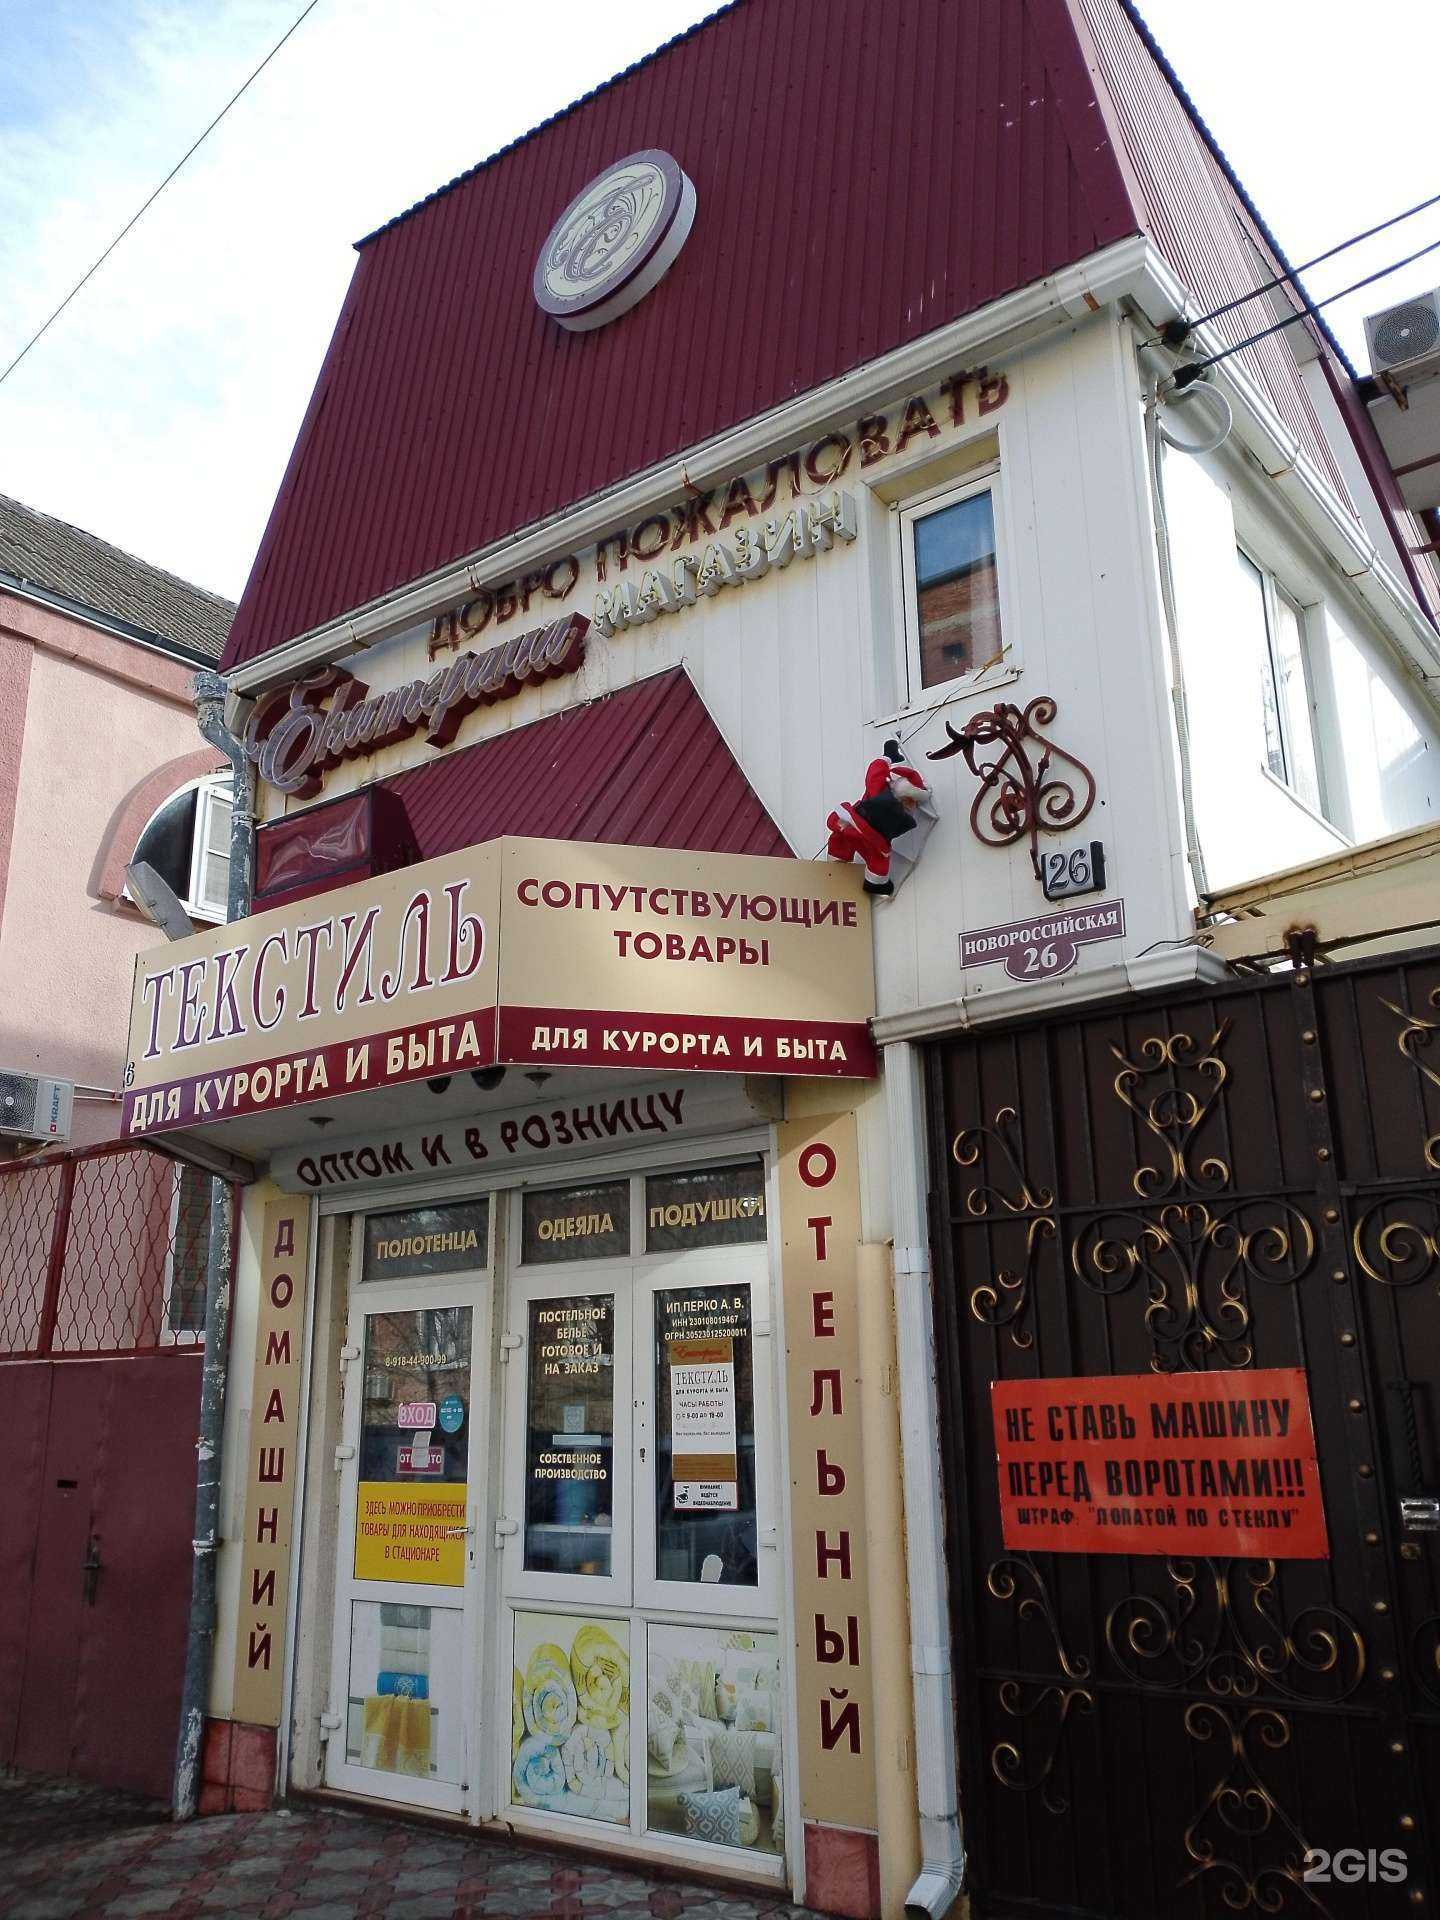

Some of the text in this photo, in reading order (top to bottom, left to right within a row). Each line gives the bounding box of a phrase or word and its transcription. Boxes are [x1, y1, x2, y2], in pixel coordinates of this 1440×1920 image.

[428, 364, 1010, 662] ДОБРО ПОЖАЛОВАТЬ
[592, 488, 858, 638] МАГАЗИН
[1047, 849, 1091, 891] 26
[515, 877, 859, 928] СОПУТСТВУЮЩИЕ
[613, 930, 771, 967] ТОВАРЫ
[964, 910, 1118, 955] НОВОРОССИЙСКАЯ
[142, 880, 484, 1060] ТЕКСТИЛЬ
[1023, 942, 1059, 973] 26
[531, 1026, 848, 1061] ДЛЯ КУРОРТА И БЫТА
[130, 1019, 482, 1134] ДЛЯ КУРОРТА И БЫТА
[50, 1084, 62, 1120] KRAFT
[295, 1089, 686, 1188] ОПТОМ И В РОЗНИЦУ
[537, 1212, 614, 1242] ОДЕЯЛА
[649, 1196, 765, 1229] ПОДУШКИ
[376, 1229, 478, 1260] ПОЛОТЕНЦА
[539, 1308, 606, 1323] ПОСТЕЛЬНОЕ
[666, 1298, 744, 1313] ИП ПЕРКО А. В.
[664, 1331, 684, 1341] ОГРН
[672, 1318, 688, 1327] ИНН
[542, 1343, 602, 1357] ГОТОВОЕ И
[545, 1361, 599, 1375] НА ЗАКАЗ
[400, 1406, 434, 1426] ВХОД
[1005, 1398, 1290, 1442] НЕ СТАВЬ МАШИНУ
[247, 1219, 296, 1670] ДОМАШНИЙ
[539, 1453, 601, 1464] СОБСТВЕННОЕ
[798, 1142, 861, 1754] ОТЕЛЬНЫЙ
[535, 1468, 607, 1480] ПРОИЗВОДСТВО
[1008, 1458, 1305, 1503] ПЕРЕД ВОРОТАМИ!!!
[365, 1501, 465, 1518] ЗДЕСЬ МОЖНО ПРИОБРЕСТИ
[1186, 1509, 1208, 1525] ПО
[361, 1522, 389, 1536] ТОВАРЫ
[392, 1523, 406, 1540] ДЛЯ
[385, 1545, 440, 1563] В СТАЦИОНАРЕ
